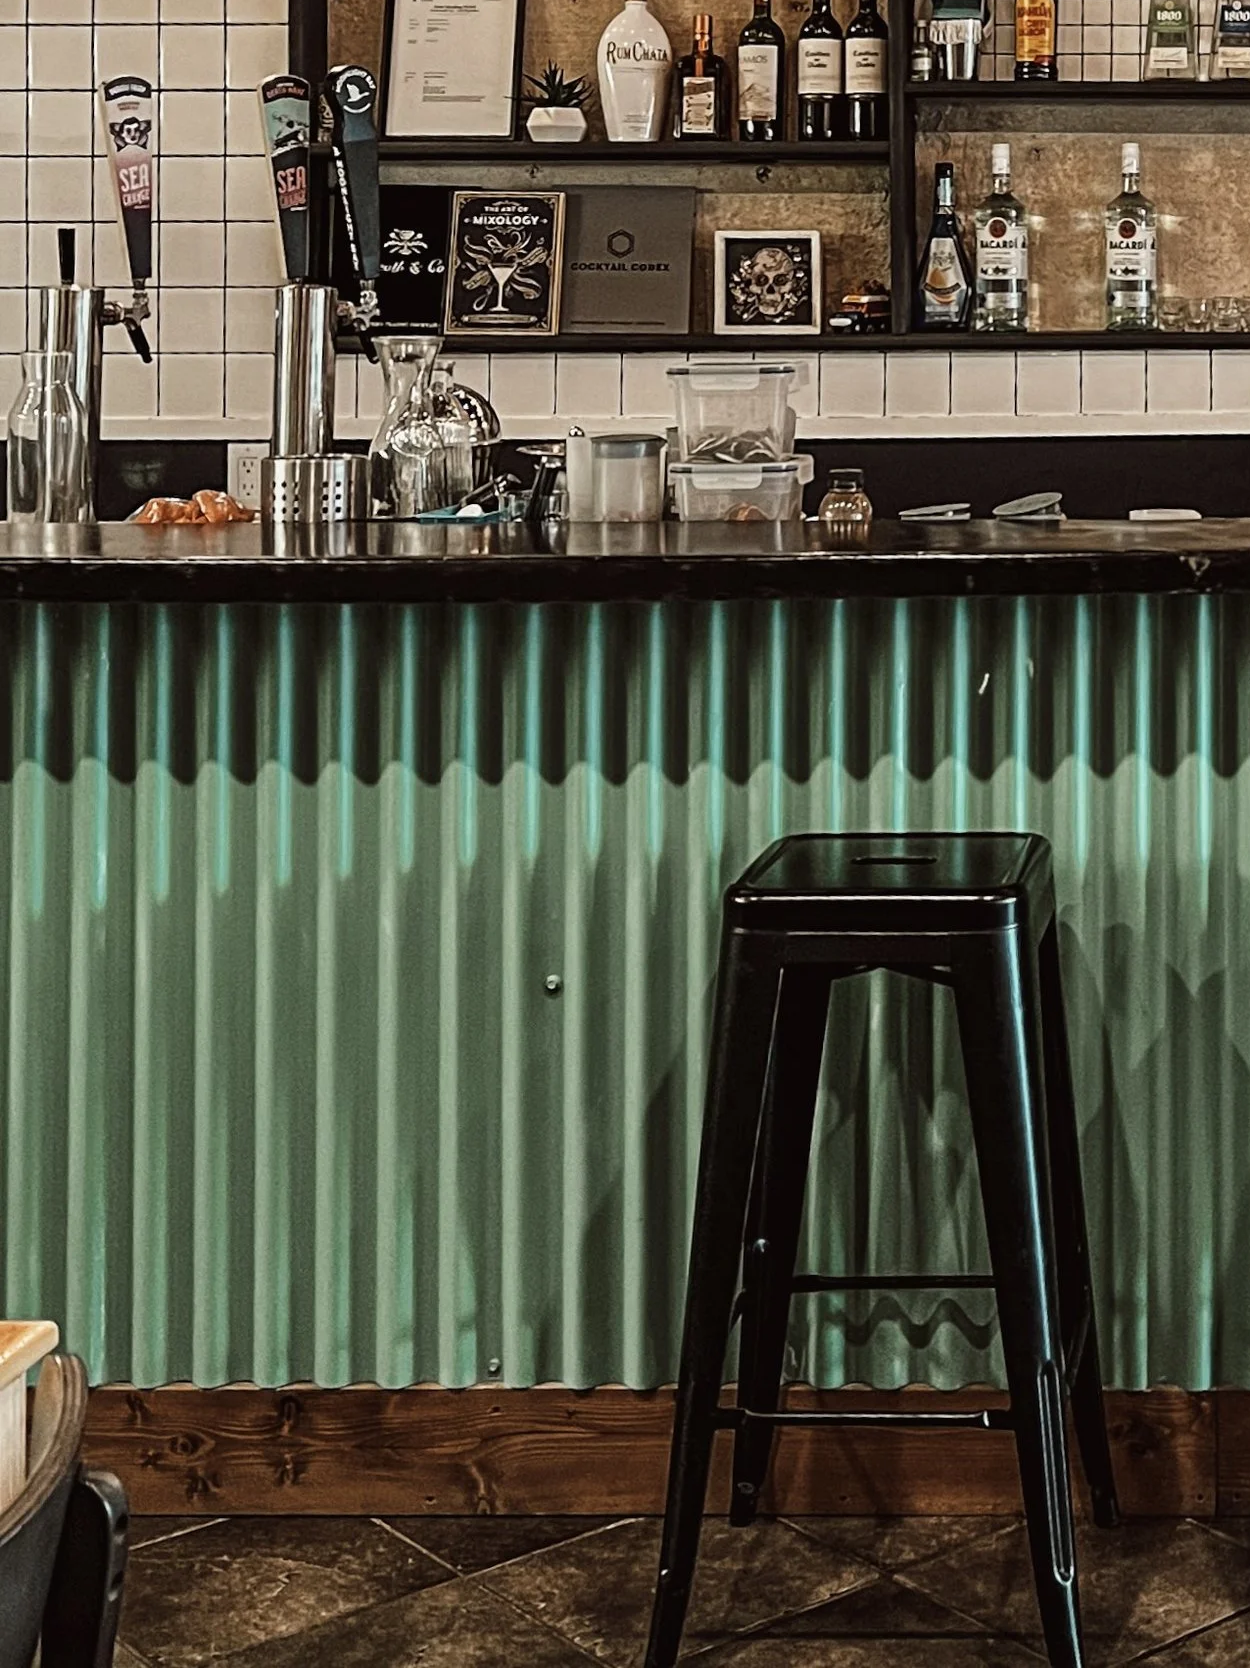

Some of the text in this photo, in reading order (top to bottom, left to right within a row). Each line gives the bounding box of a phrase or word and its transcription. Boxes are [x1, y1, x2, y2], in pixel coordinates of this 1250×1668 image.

[1157, 11, 1182, 21] 1800
[1224, 11, 1250, 22] 1800
[119, 163, 150, 193] SEA
[276, 165, 306, 194] SEA
[484, 205, 499, 213] THE
[517, 205, 530, 213] OF
[472, 215, 540, 225] MIXOLOGY
[427, 258, 446, 274] Co
[570, 262, 671, 272] COCKTAIL CODEX
